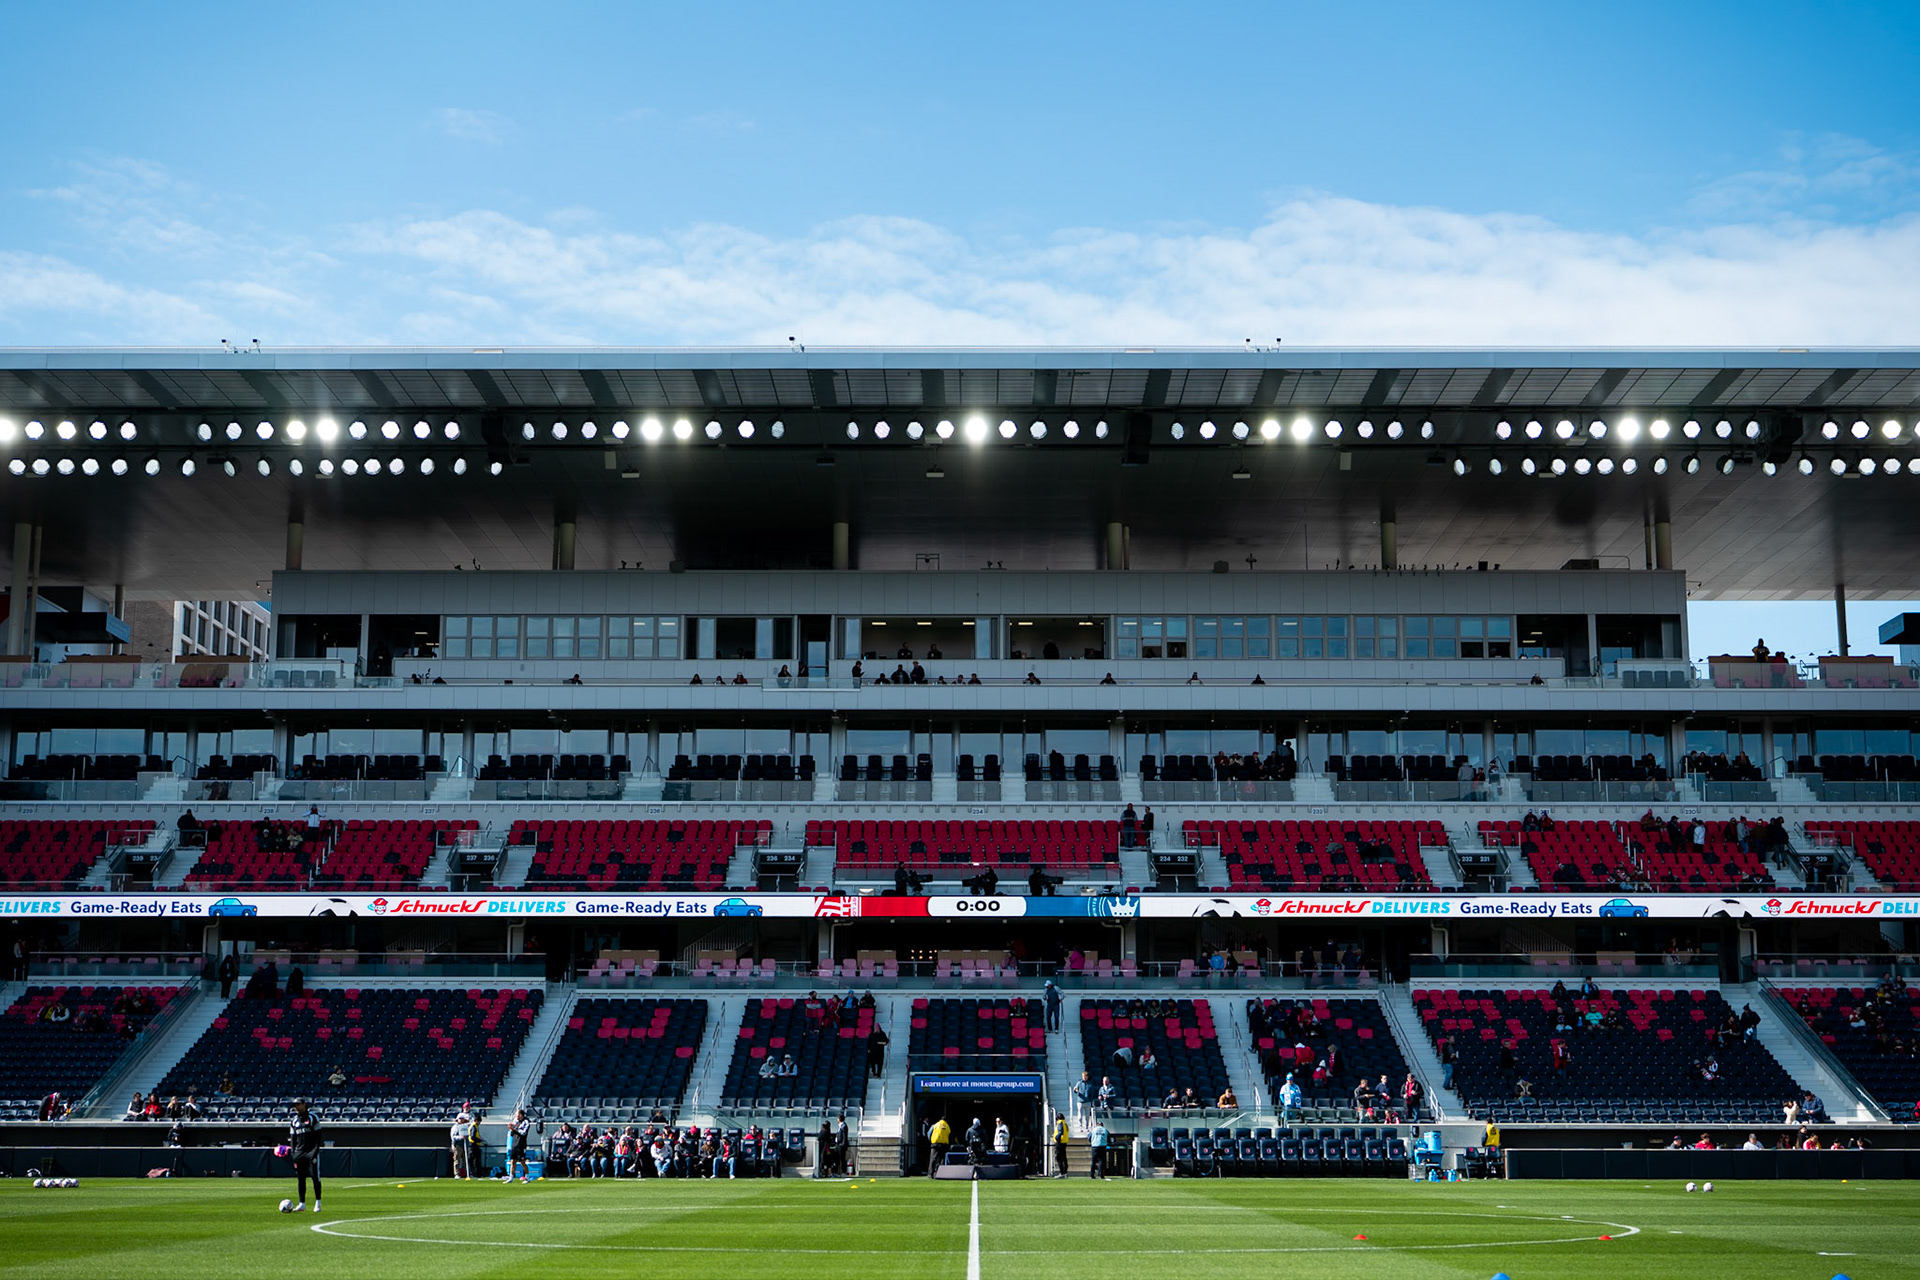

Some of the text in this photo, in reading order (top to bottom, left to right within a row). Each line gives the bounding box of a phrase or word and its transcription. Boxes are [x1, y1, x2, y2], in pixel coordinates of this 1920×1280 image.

[71, 901, 166, 916] Game-Ready
[172, 902, 202, 913] Eats
[488, 901, 566, 913] DELIVERS
[576, 901, 672, 916] Game-Ready
[676, 902, 706, 913] Eats
[957, 901, 1000, 911] 0:00
[1372, 902, 1450, 913] DELIVERS
[1460, 902, 1556, 916] Game-Ready
[1562, 902, 1592, 914] Eats
[1882, 902, 1919, 914] DELI
